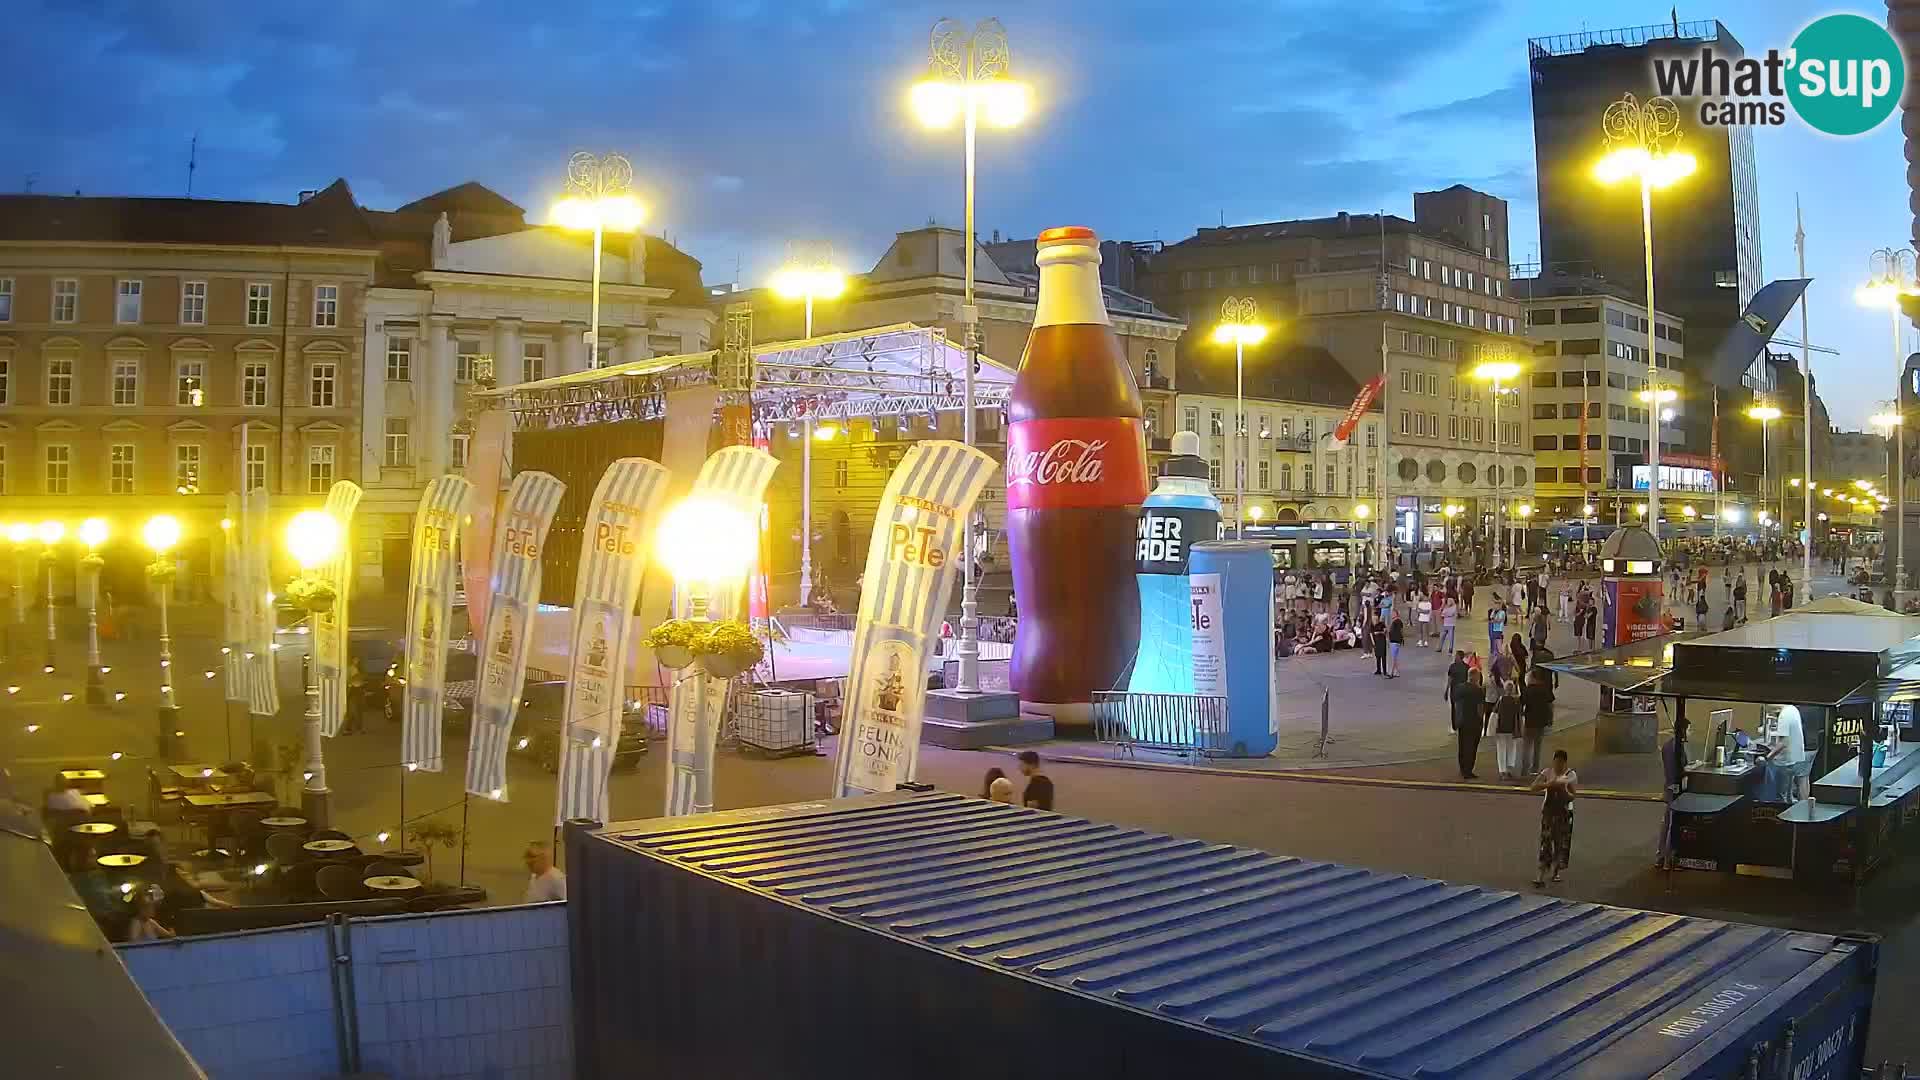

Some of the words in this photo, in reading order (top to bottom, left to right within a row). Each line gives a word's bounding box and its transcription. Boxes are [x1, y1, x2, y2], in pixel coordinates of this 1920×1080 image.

[506, 527, 537, 558] PeTe
[596, 523, 634, 555] PeTe
[890, 524, 944, 567] PeTe
